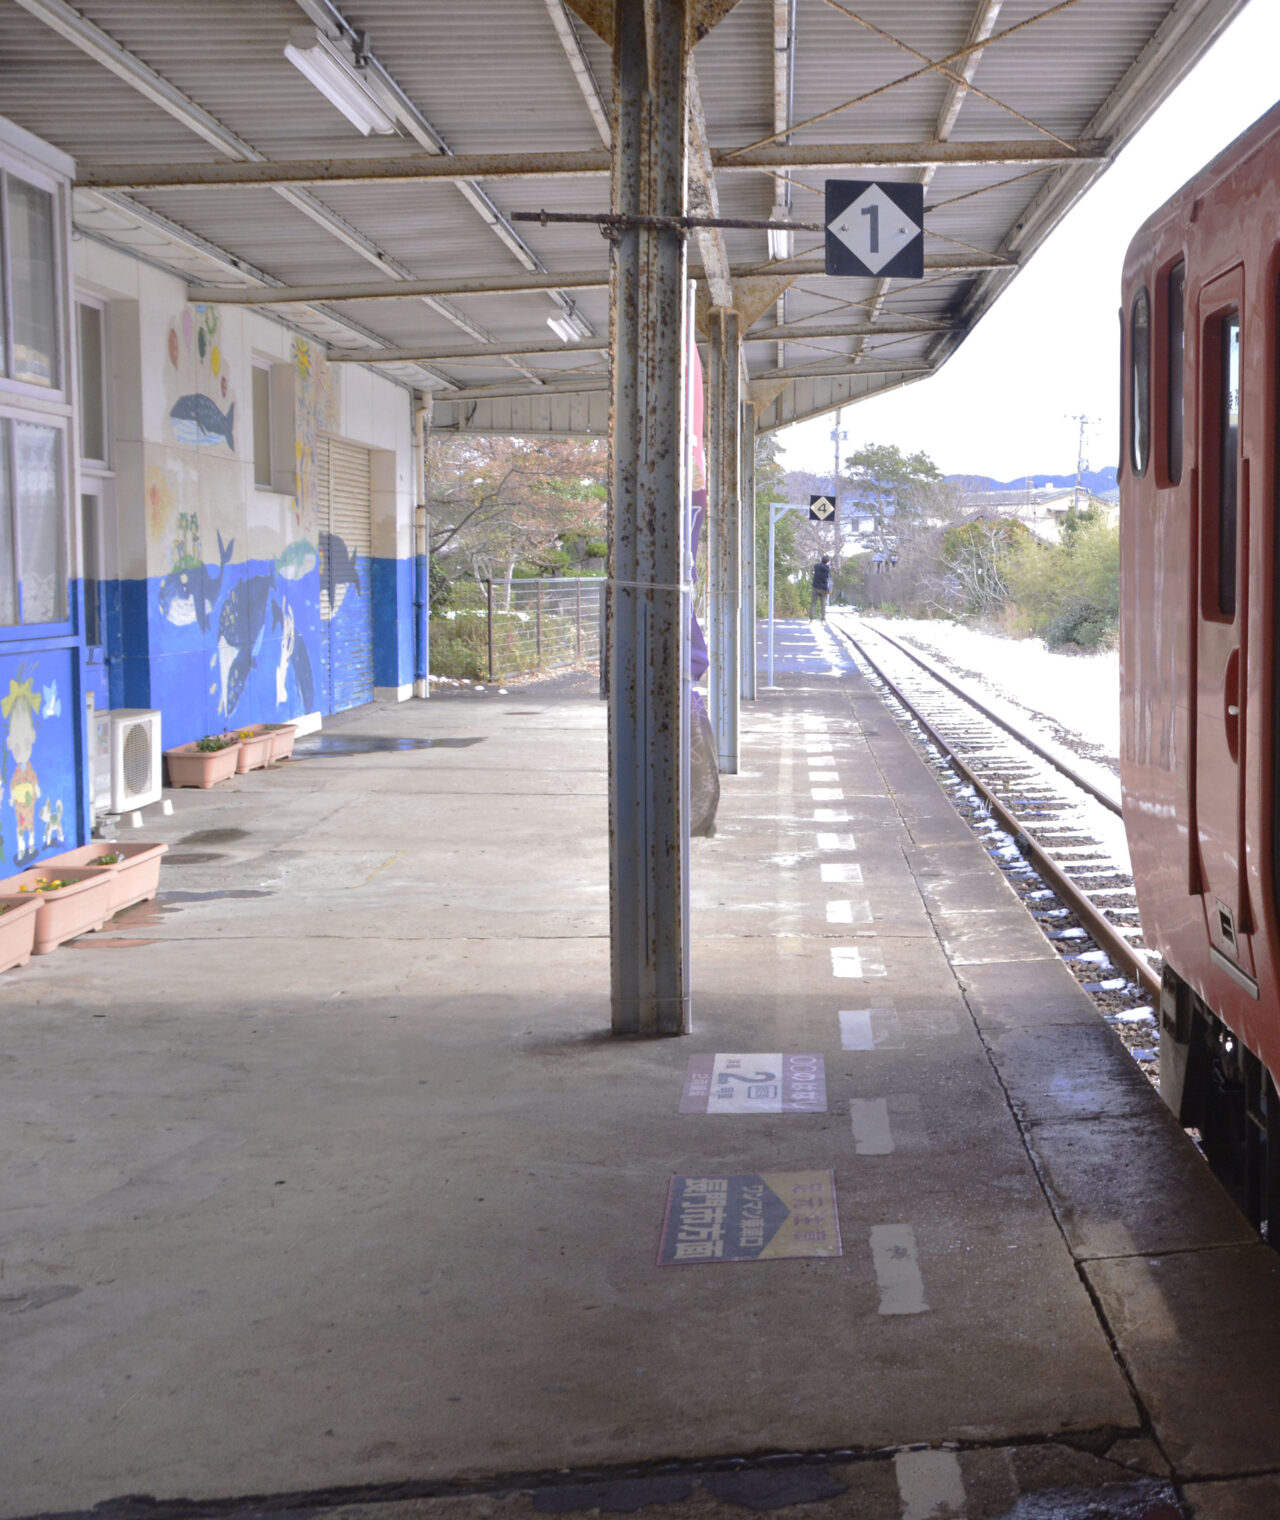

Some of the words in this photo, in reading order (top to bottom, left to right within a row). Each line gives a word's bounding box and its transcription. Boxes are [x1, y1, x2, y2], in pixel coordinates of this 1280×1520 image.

[860, 204, 880, 253] 1
[817, 503, 828, 515] 4
[673, 1177, 729, 1260] 長門市方面
[738, 1184, 766, 1248] ワンマン乗車口
[792, 1182, 827, 1242] 足元注意
